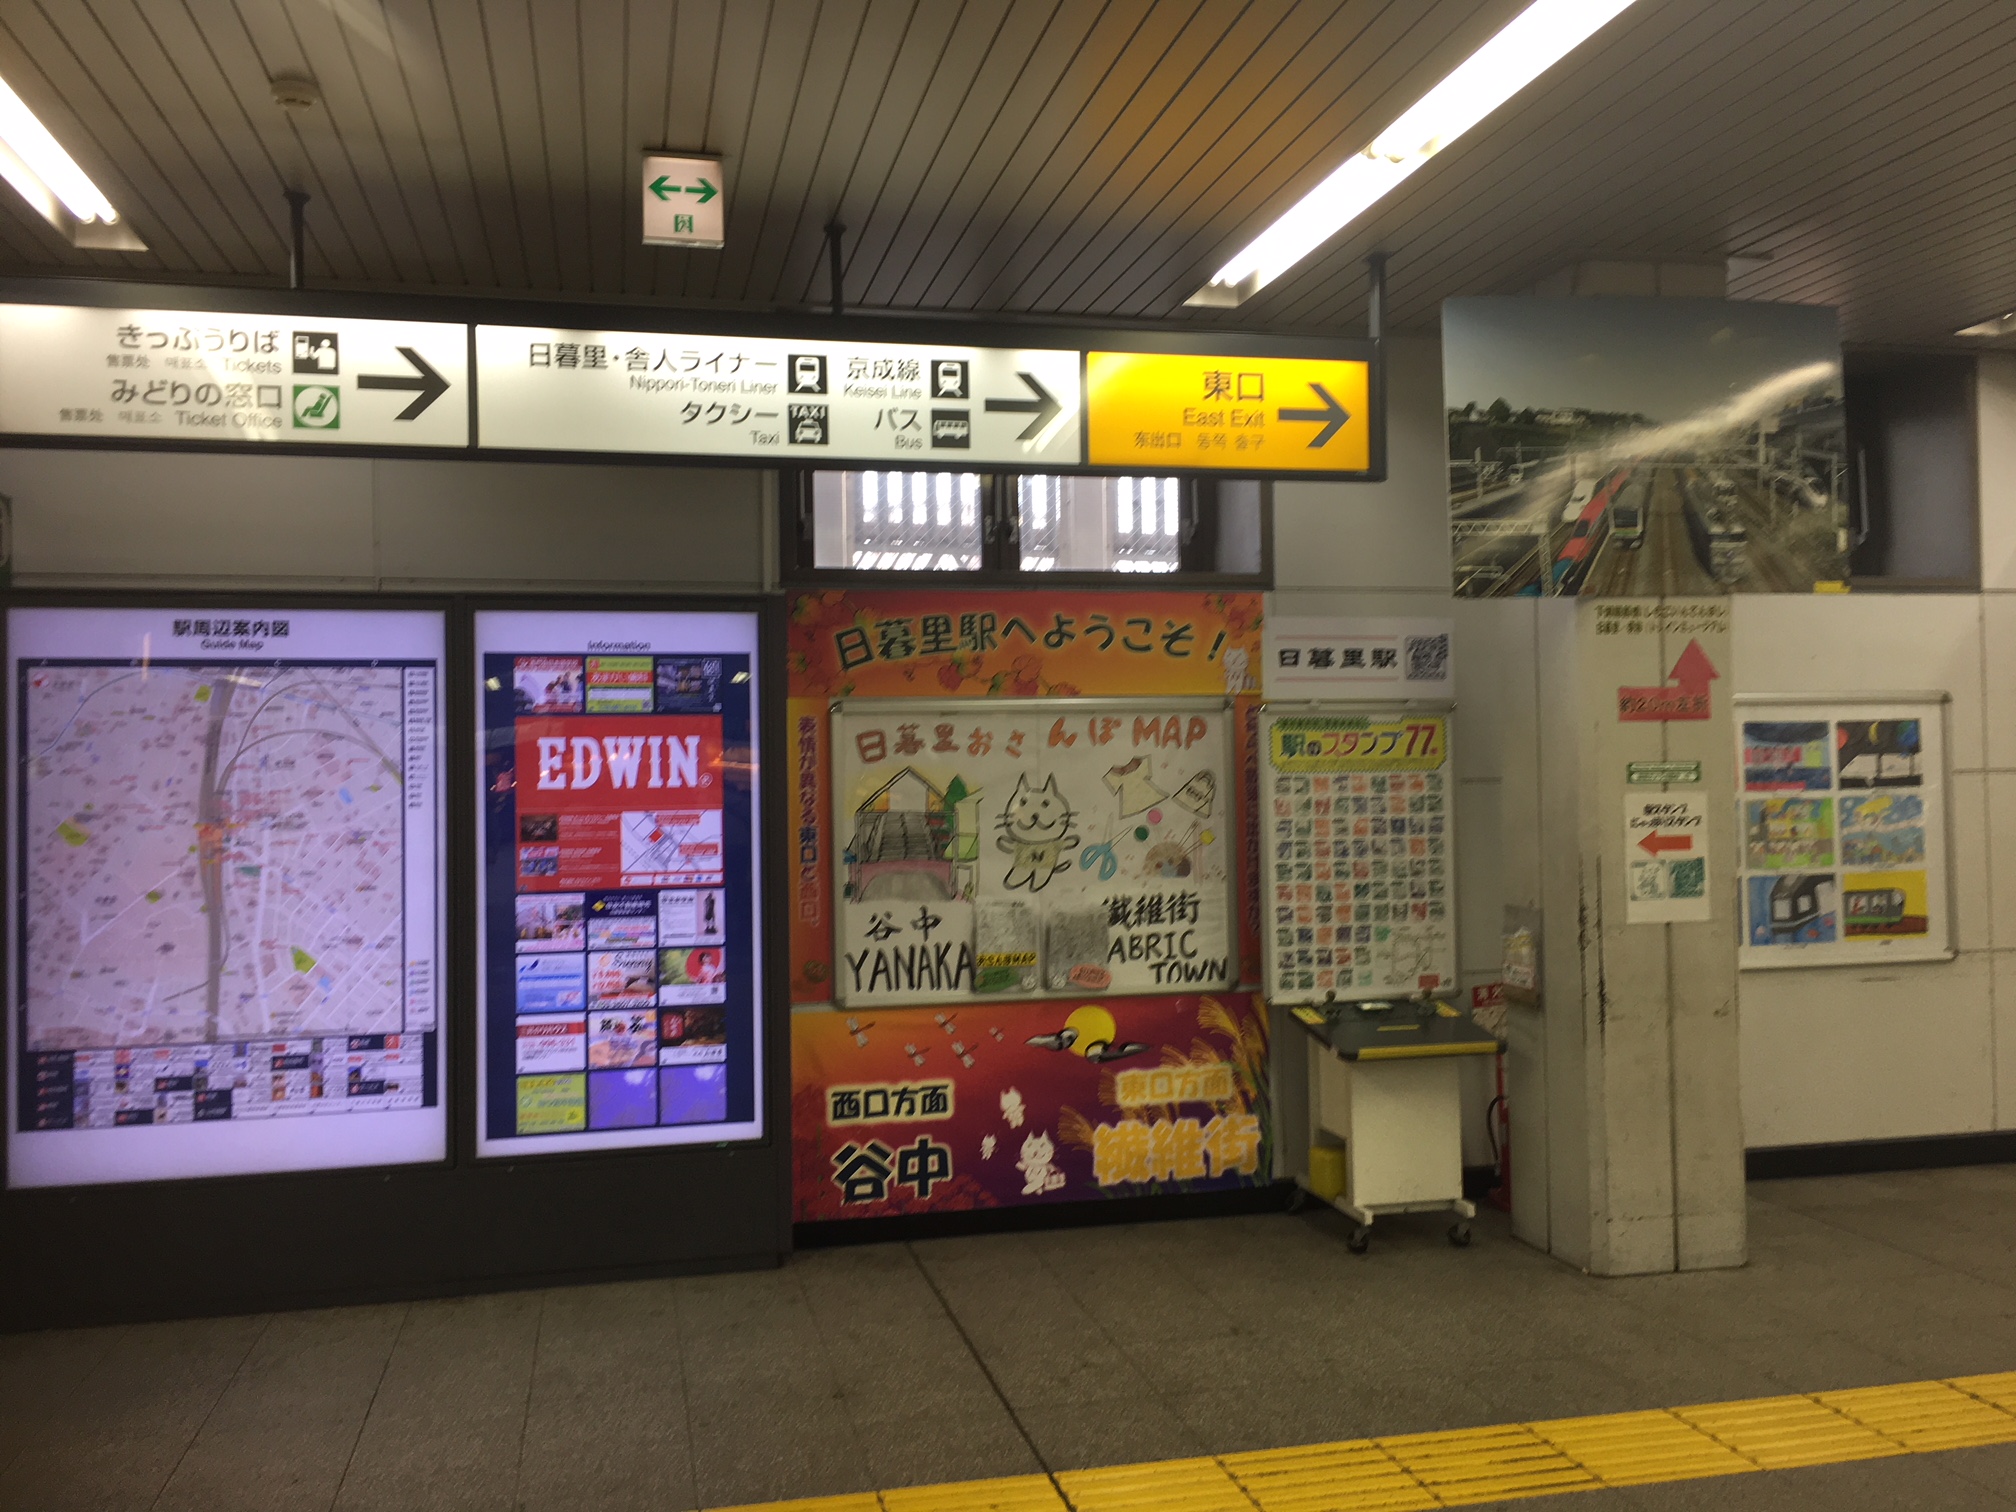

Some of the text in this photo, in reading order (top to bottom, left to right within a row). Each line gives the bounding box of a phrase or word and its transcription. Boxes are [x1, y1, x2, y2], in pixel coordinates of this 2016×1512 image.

[117, 323, 280, 354] きっぷうりば
[223, 357, 282, 375] Tickets
[528, 341, 778, 374] 日暮里・舎人ライナー
[846, 356, 921, 382] 京成線
[111, 378, 283, 410] みどりの窓口
[629, 374, 779, 397] Nippori-Toneri Liner
[843, 382, 923, 399] Keisei Line
[1203, 370, 1266, 402] 東口
[175, 409, 283, 429] Ticket Office
[680, 403, 779, 426] タクシー
[790, 404, 828, 419] TAXI
[874, 406, 923, 432] バス
[1183, 407, 1267, 429] East Exit
[750, 429, 781, 447] Taxi
[894, 434, 924, 451] Bus
[200, 638, 265, 653] Guide Map
[587, 639, 652, 652] Information
[833, 611, 1228, 672] 日暮里駅へようこそ！
[1278, 647, 1399, 669] 日暮里駅
[536, 735, 701, 791] EDWIN
[864, 904, 943, 943] 谷中
[844, 939, 977, 994] YANAKA
[1148, 956, 1229, 986] TOWN
[1119, 1066, 1234, 1102] 東口方面
[830, 1085, 950, 1122] 西口方面
[832, 1137, 952, 1202] 谷中
